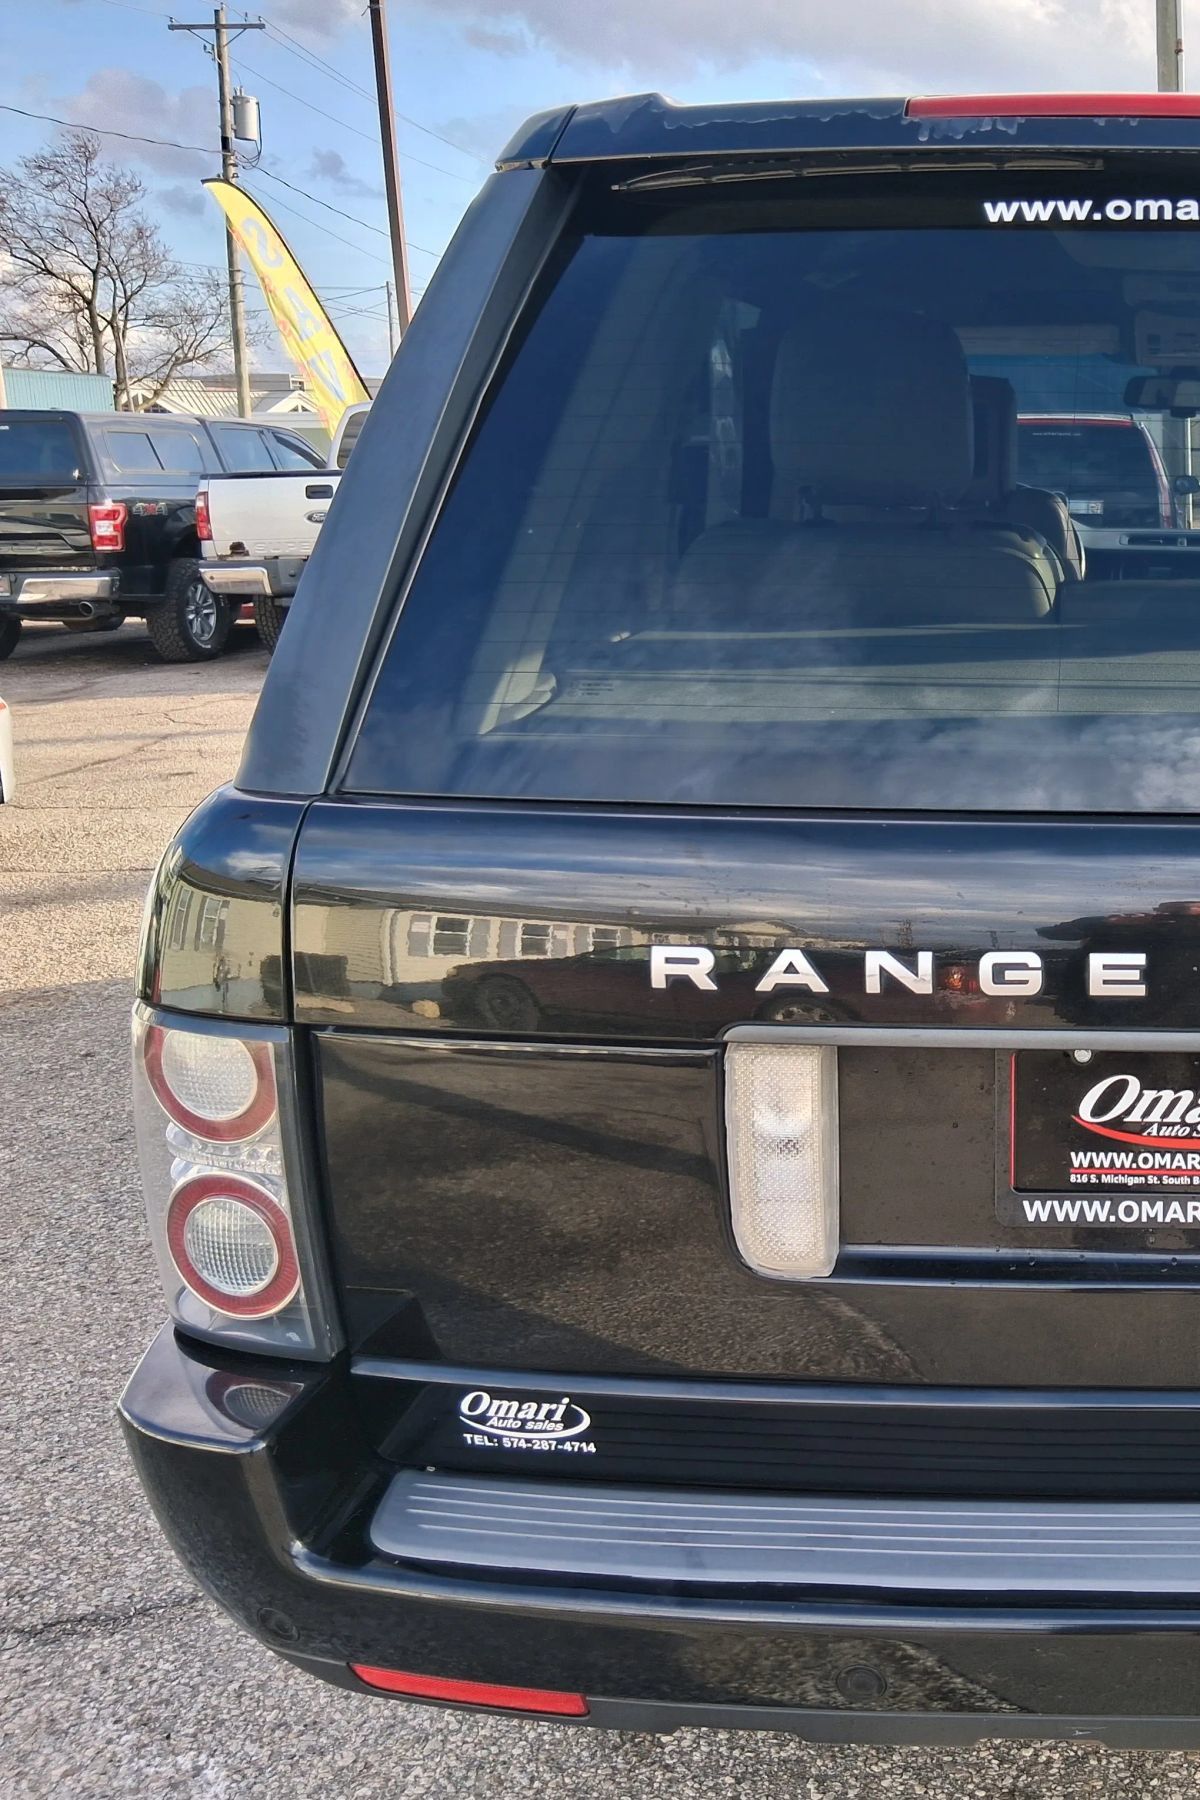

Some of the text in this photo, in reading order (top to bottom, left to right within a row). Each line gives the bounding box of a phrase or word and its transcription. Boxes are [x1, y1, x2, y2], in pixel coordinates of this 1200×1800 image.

[255, 542, 311, 553] SUPE
[650, 945, 1147, 996] RANGE
[1142, 1122, 1190, 1137] Auto
[1069, 1174, 1088, 1183] 816
[1089, 1174, 1099, 1183] S.
[1101, 1174, 1146, 1186] Michigan
[1147, 1176, 1161, 1184] St.
[1162, 1175, 1191, 1185] South
[460, 1391, 570, 1421] Omari
[486, 1416, 564, 1432] Auto sales
[463, 1433, 597, 1453] TEL: 574-287-4714
